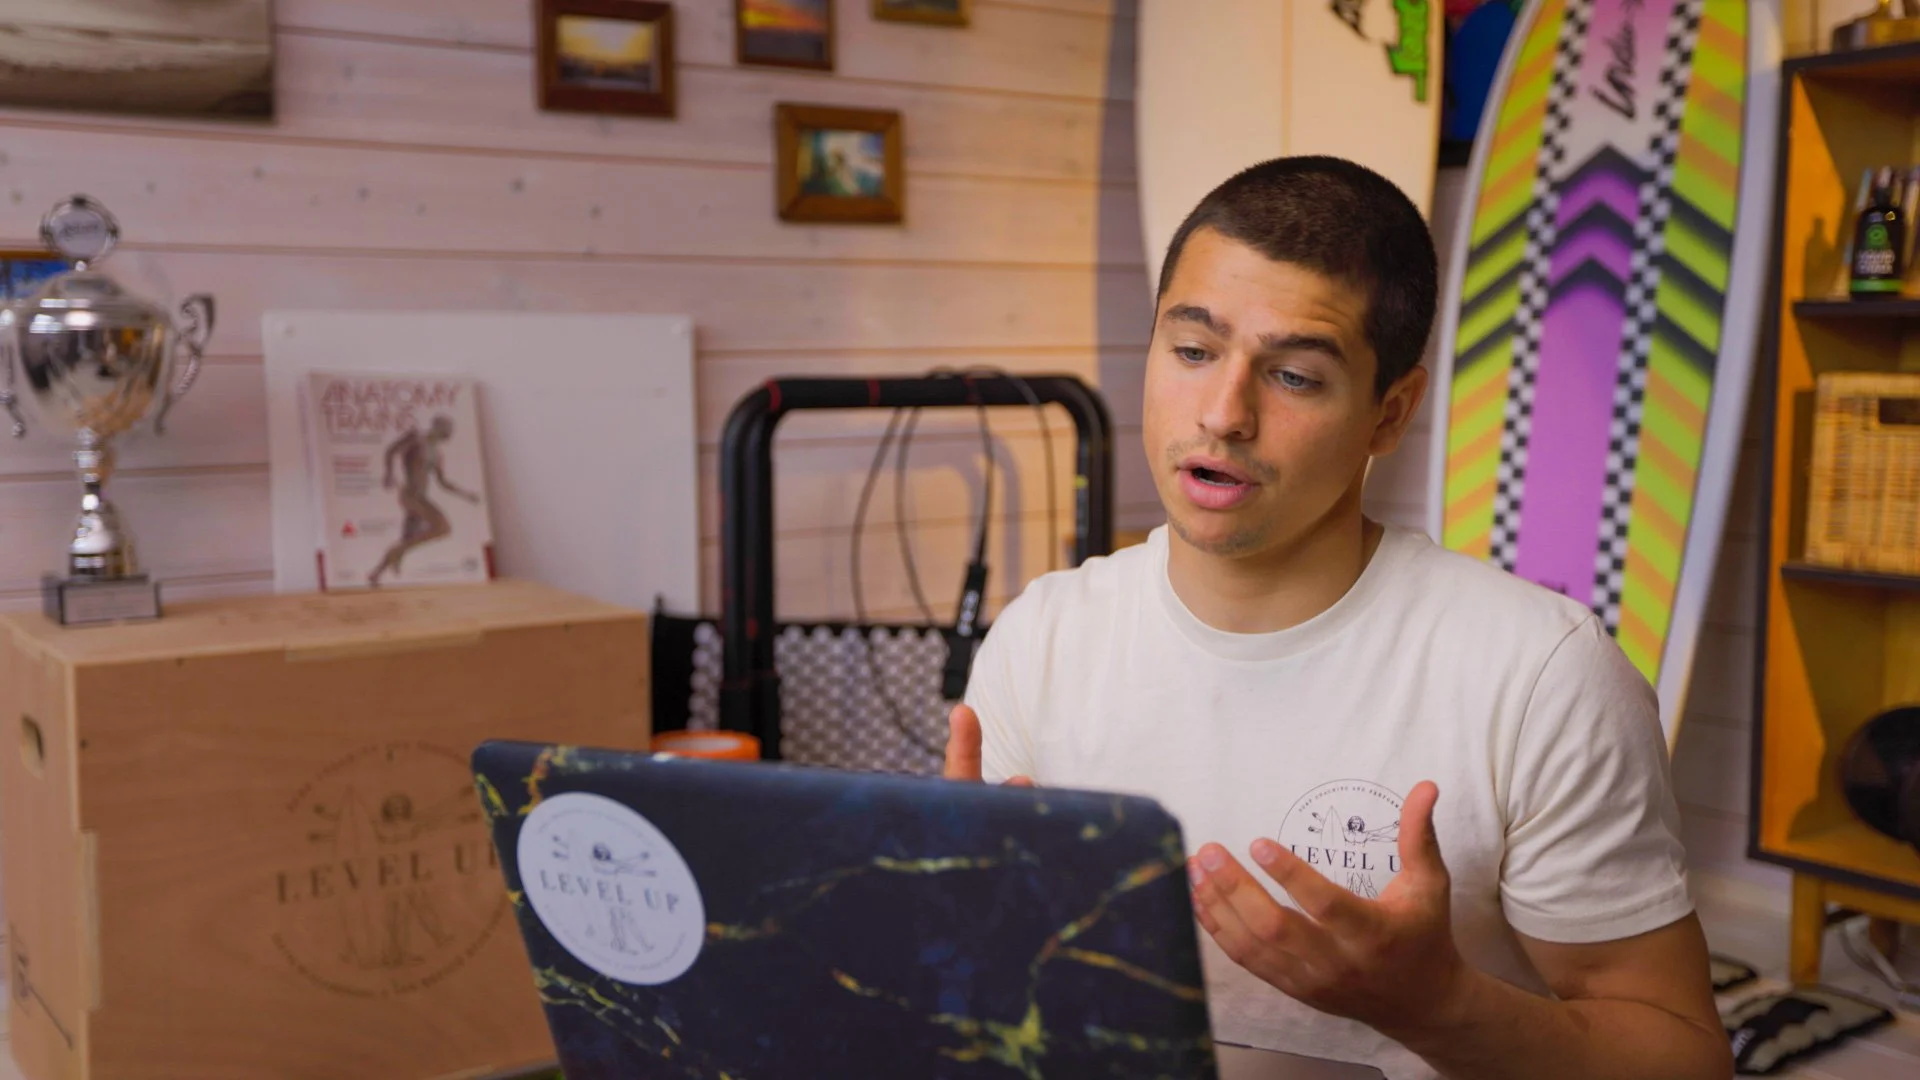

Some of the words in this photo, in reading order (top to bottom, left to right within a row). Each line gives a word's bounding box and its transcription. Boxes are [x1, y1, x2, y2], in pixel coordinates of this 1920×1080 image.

[321, 379, 462, 407] ANATOMY
[276, 852, 433, 904] LEVEL
[1387, 854, 1402, 873] U
[540, 869, 633, 905] LEVEL
[644, 887, 680, 914] UP
